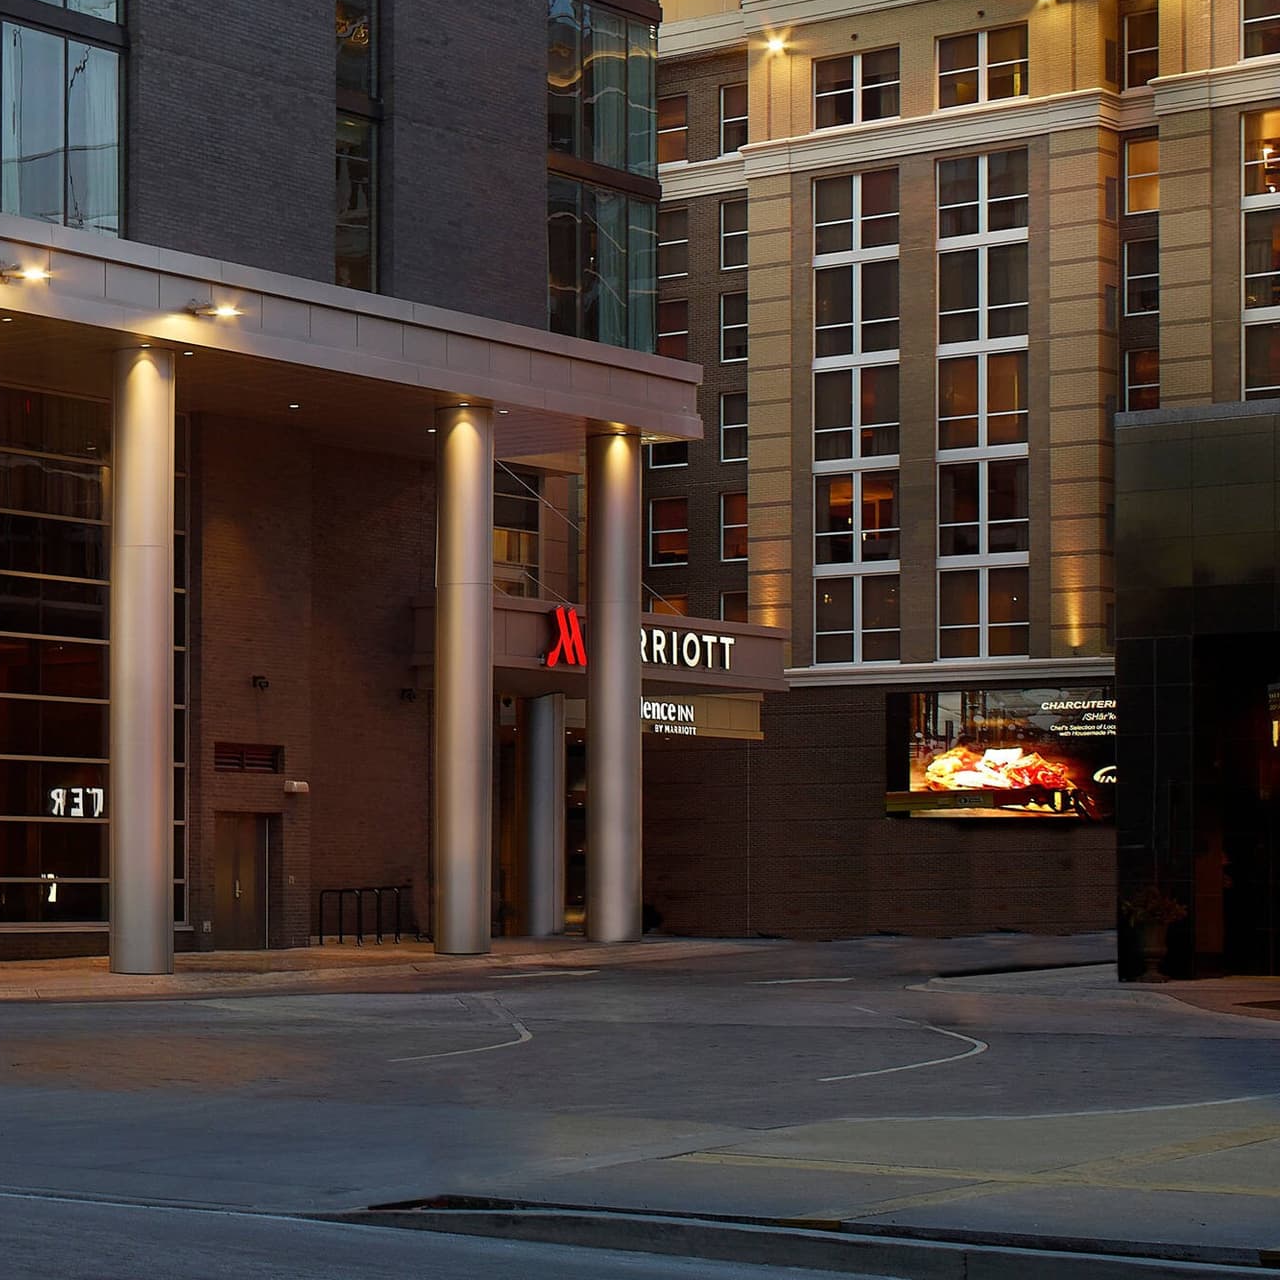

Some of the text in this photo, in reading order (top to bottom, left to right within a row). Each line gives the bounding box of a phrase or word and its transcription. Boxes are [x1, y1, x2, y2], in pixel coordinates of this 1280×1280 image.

[641, 628, 735, 670] RRIOTT
[1041, 700, 1117, 710] CHARCUTERI
[677, 704, 694, 722] INN
[654, 724, 697, 735] BY MARRIOTT
